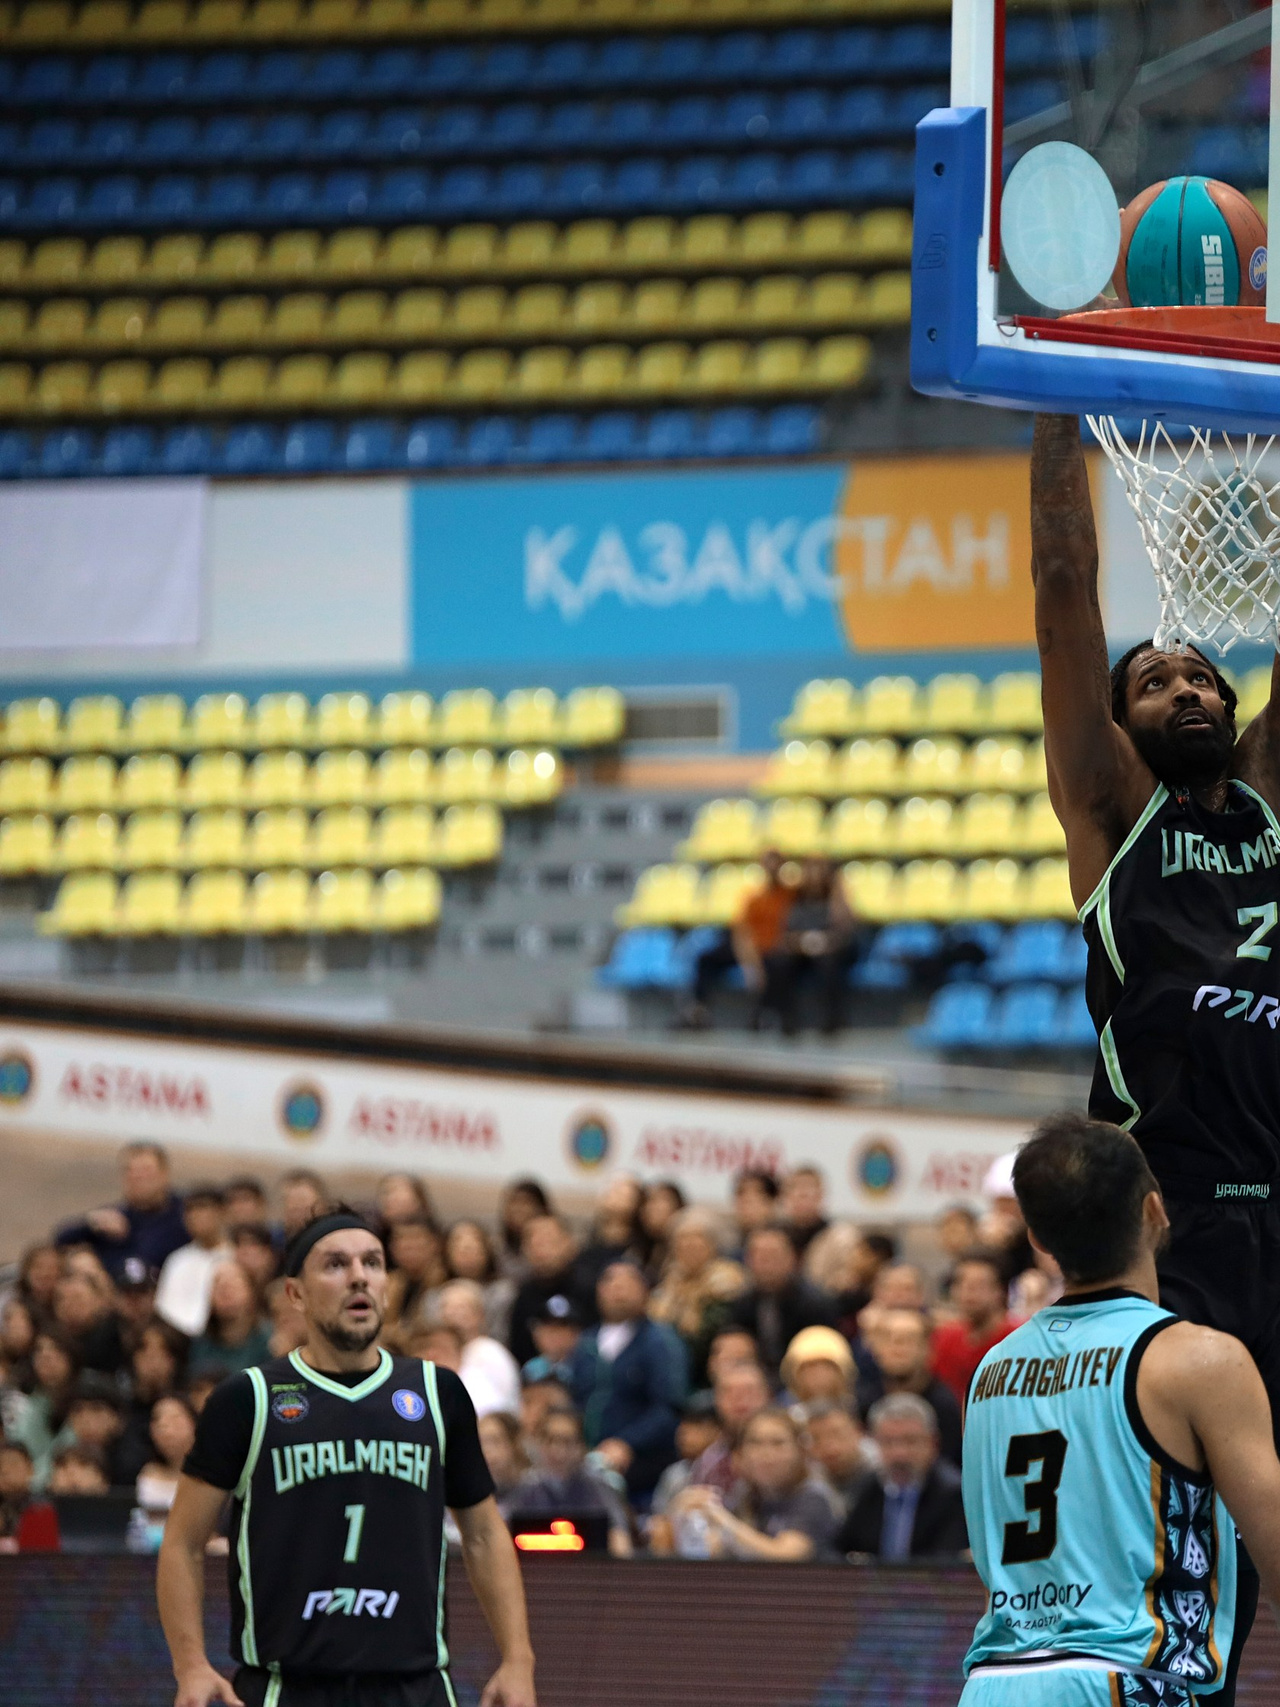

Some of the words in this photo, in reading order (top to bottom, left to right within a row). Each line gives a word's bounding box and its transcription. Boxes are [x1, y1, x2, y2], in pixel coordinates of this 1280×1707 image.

[1201, 234, 1224, 306] SIBU
[523, 514, 1012, 622] ҚАЗАҚСТАН
[1236, 901, 1279, 962] 2
[62, 1063, 211, 1117] ASTANA
[350, 1096, 503, 1151] ASTANA
[1214, 1183, 1270, 1199] УРАЛМАШ
[972, 1347, 1124, 1404] MURZAGALIYEV
[270, 1439, 432, 1494] URALMASH
[1001, 1429, 1068, 1566] 3
[343, 1503, 366, 1563] 1
[302, 1587, 400, 1621] PARI
